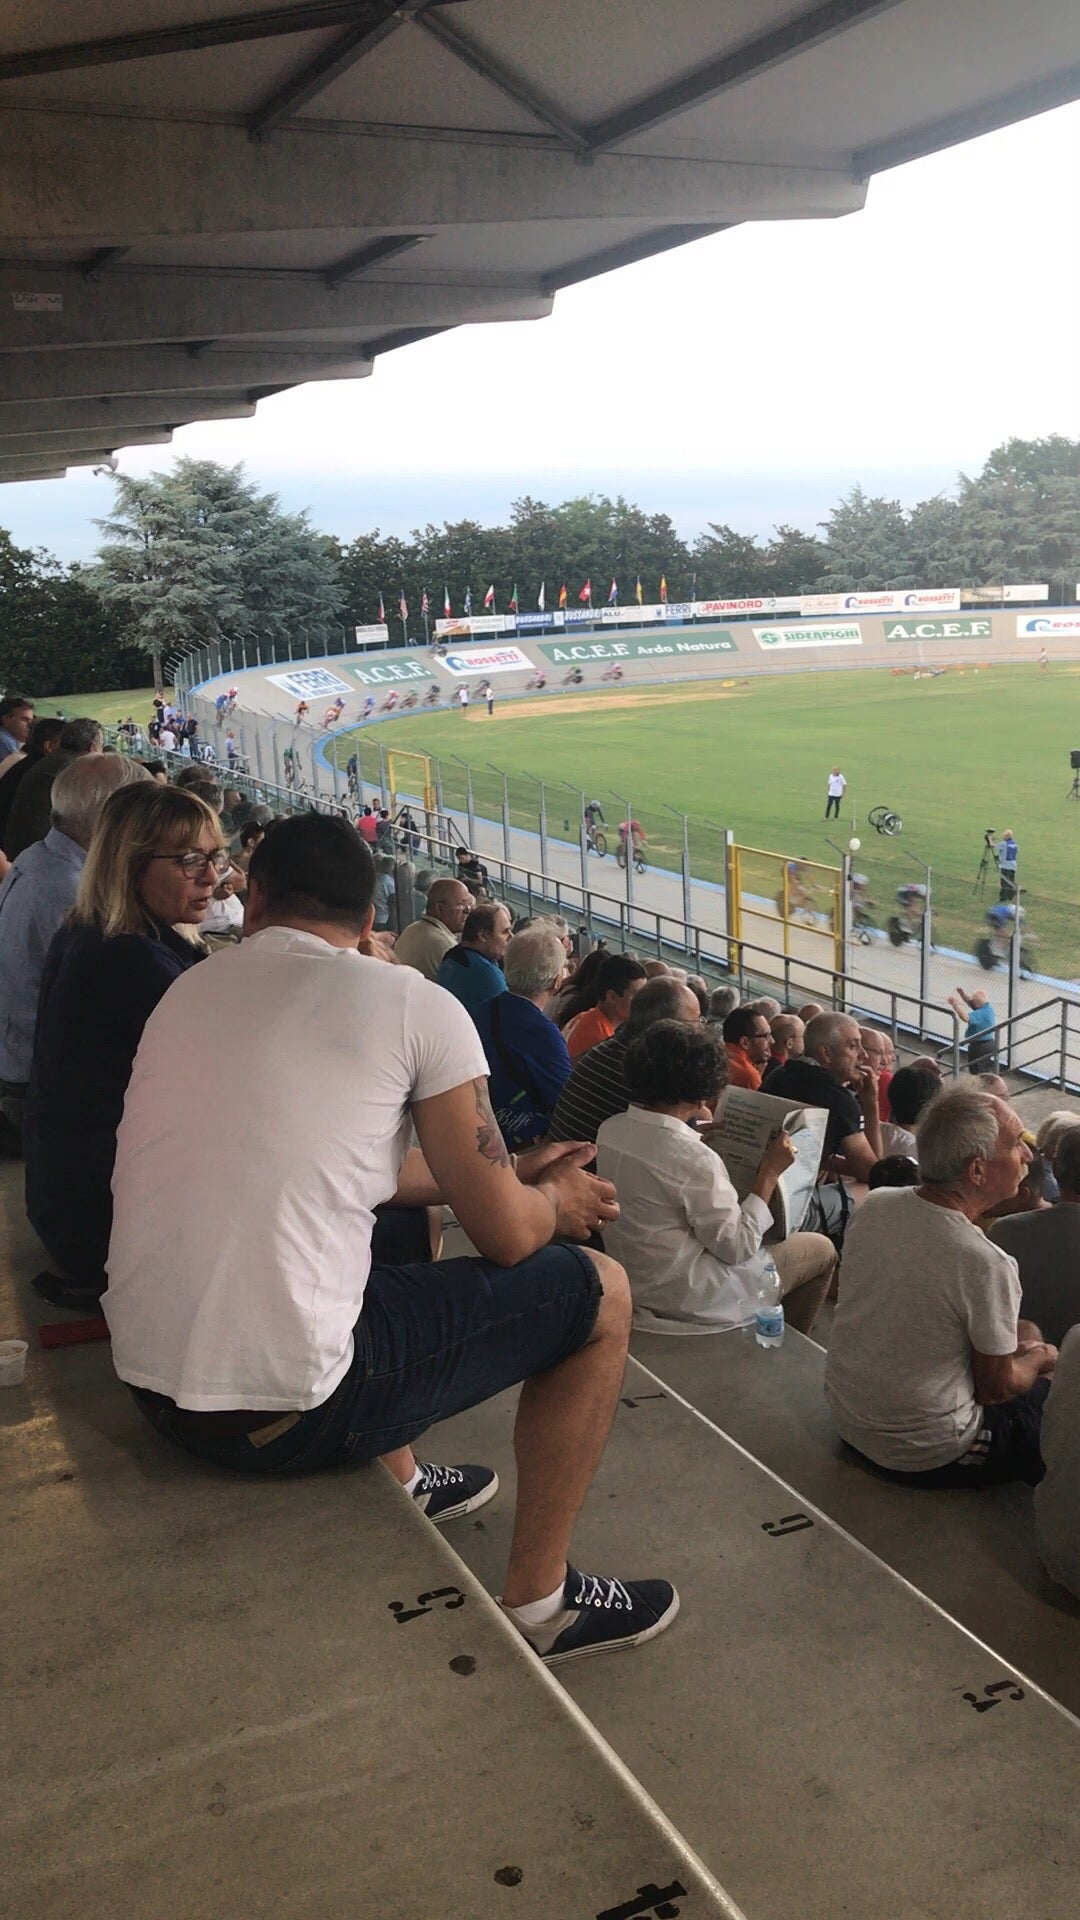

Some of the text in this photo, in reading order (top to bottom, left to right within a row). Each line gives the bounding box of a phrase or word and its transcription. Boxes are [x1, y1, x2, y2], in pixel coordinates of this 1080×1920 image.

[706, 600, 763, 611] PAVINORD
[858, 596, 894, 605] ROSSETTI
[665, 604, 691, 615] FERRI
[784, 630, 859, 641] SIDERPIGHI
[887, 622, 991, 638] A.C.E.F.
[465, 653, 520, 665] ROSSETTI
[553, 643, 630, 661] A.C.E.F.
[677, 641, 732, 652] Natura
[354, 662, 432, 685] A.C.E.F.
[761, 1513, 814, 1537] 6
[388, 1586, 466, 1624] 5
[963, 1680, 1025, 1713] 5
